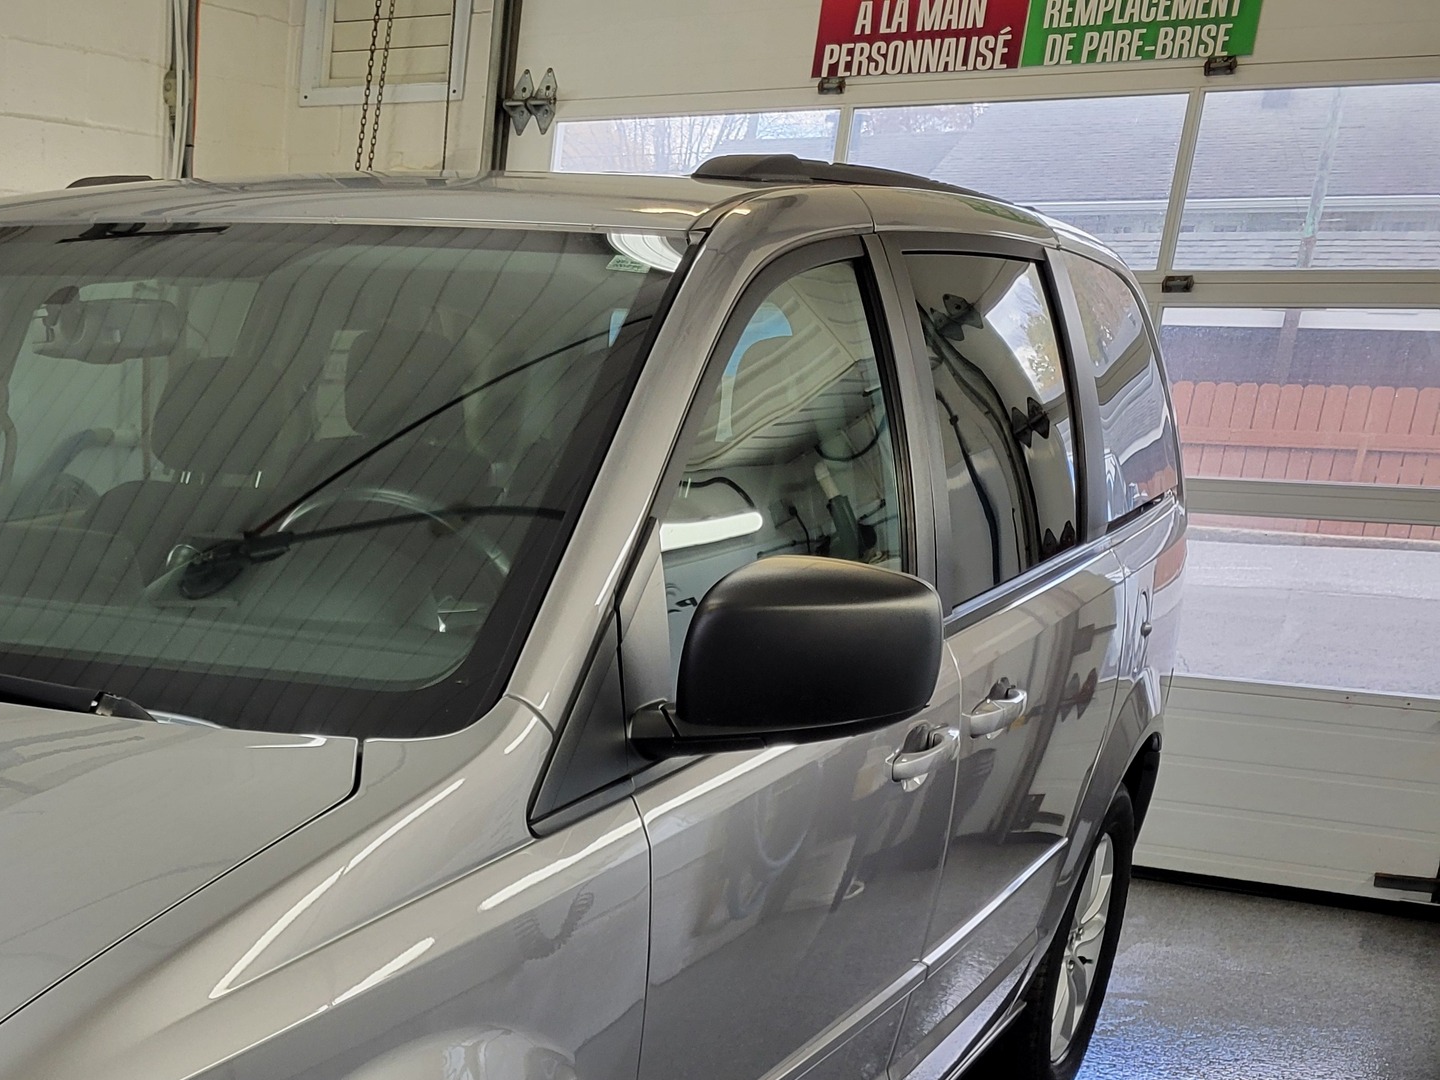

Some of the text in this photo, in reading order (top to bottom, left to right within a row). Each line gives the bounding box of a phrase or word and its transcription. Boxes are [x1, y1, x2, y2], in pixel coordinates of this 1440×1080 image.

[879, 0, 909, 34] LA
[916, 0, 988, 32] MAIN
[1042, 0, 1242, 29] REMPLACEMENT
[820, 26, 1013, 77] PERSONNALISÉ
[1043, 23, 1234, 66] DE PARE-BRISE
